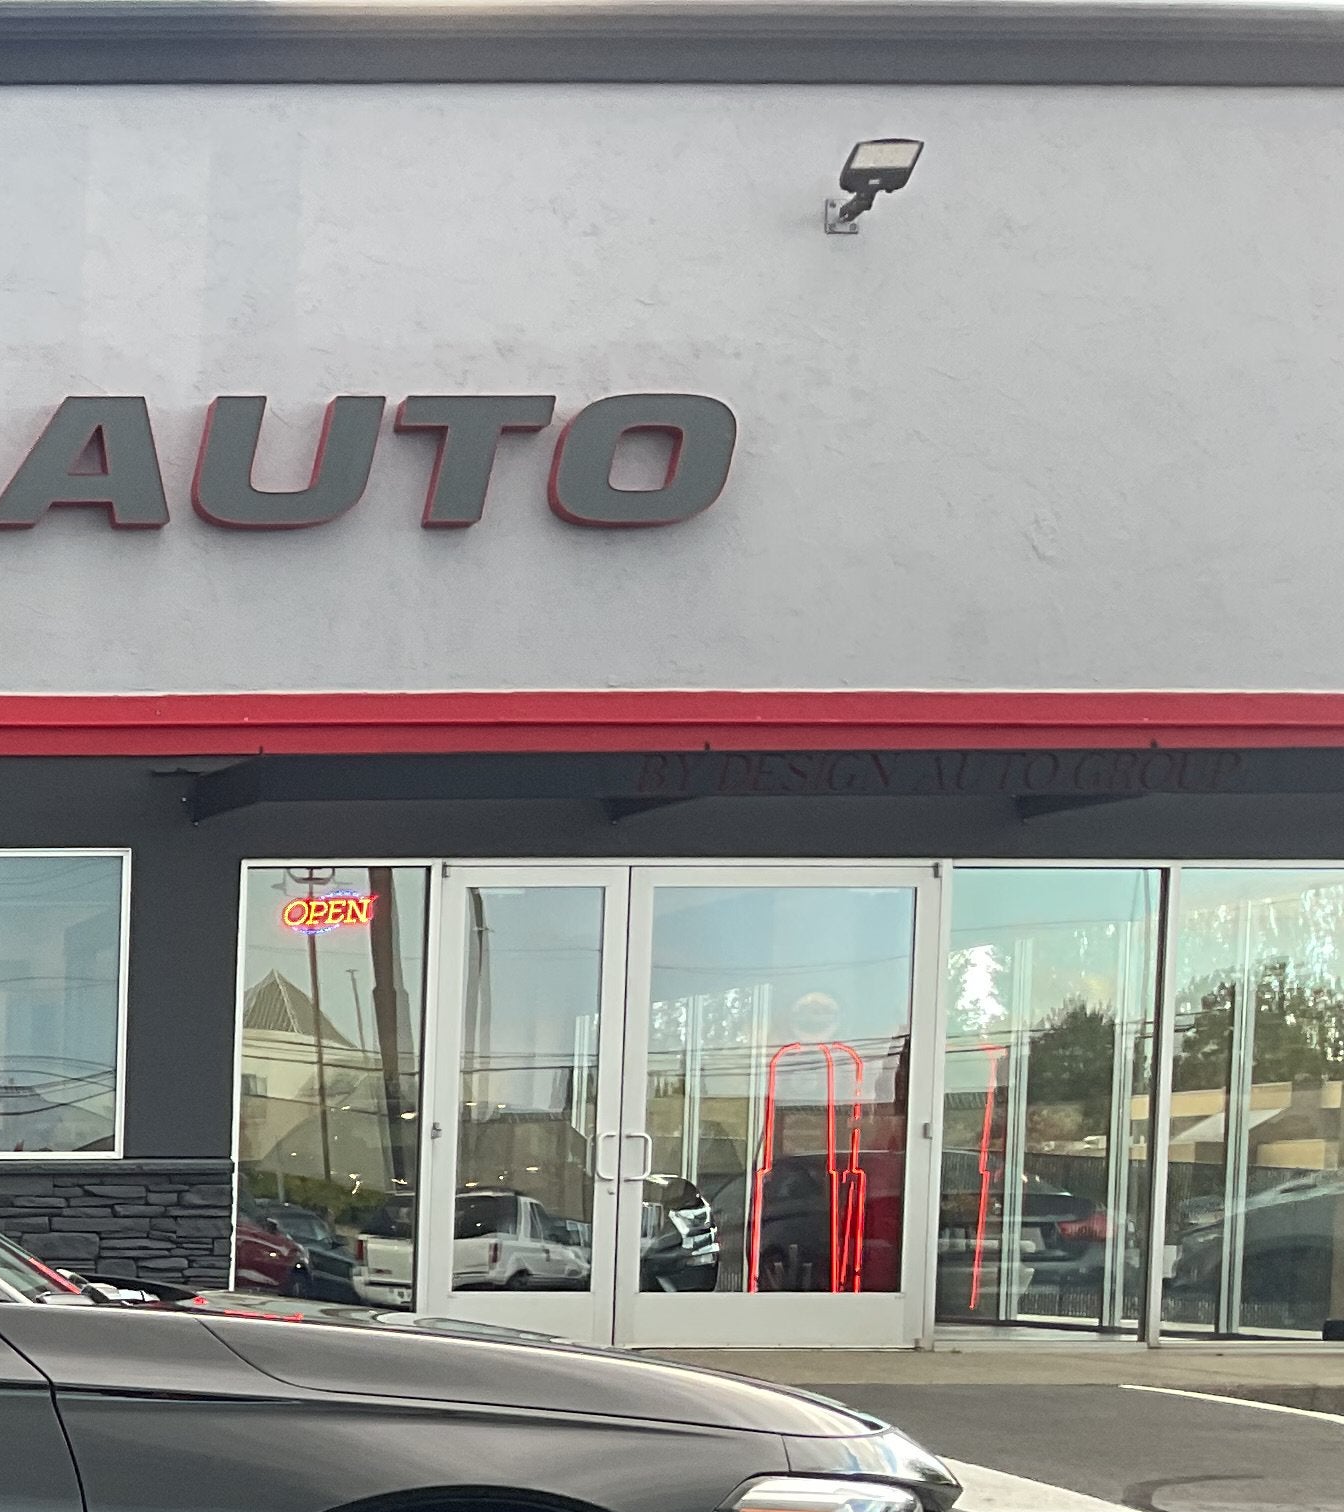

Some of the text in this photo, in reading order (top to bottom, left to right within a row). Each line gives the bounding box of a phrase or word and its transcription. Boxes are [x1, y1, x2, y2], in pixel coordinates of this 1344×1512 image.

[637, 751, 1244, 791] BY DESIGN AUTO GROUP
[283, 897, 372, 926] OPEN
